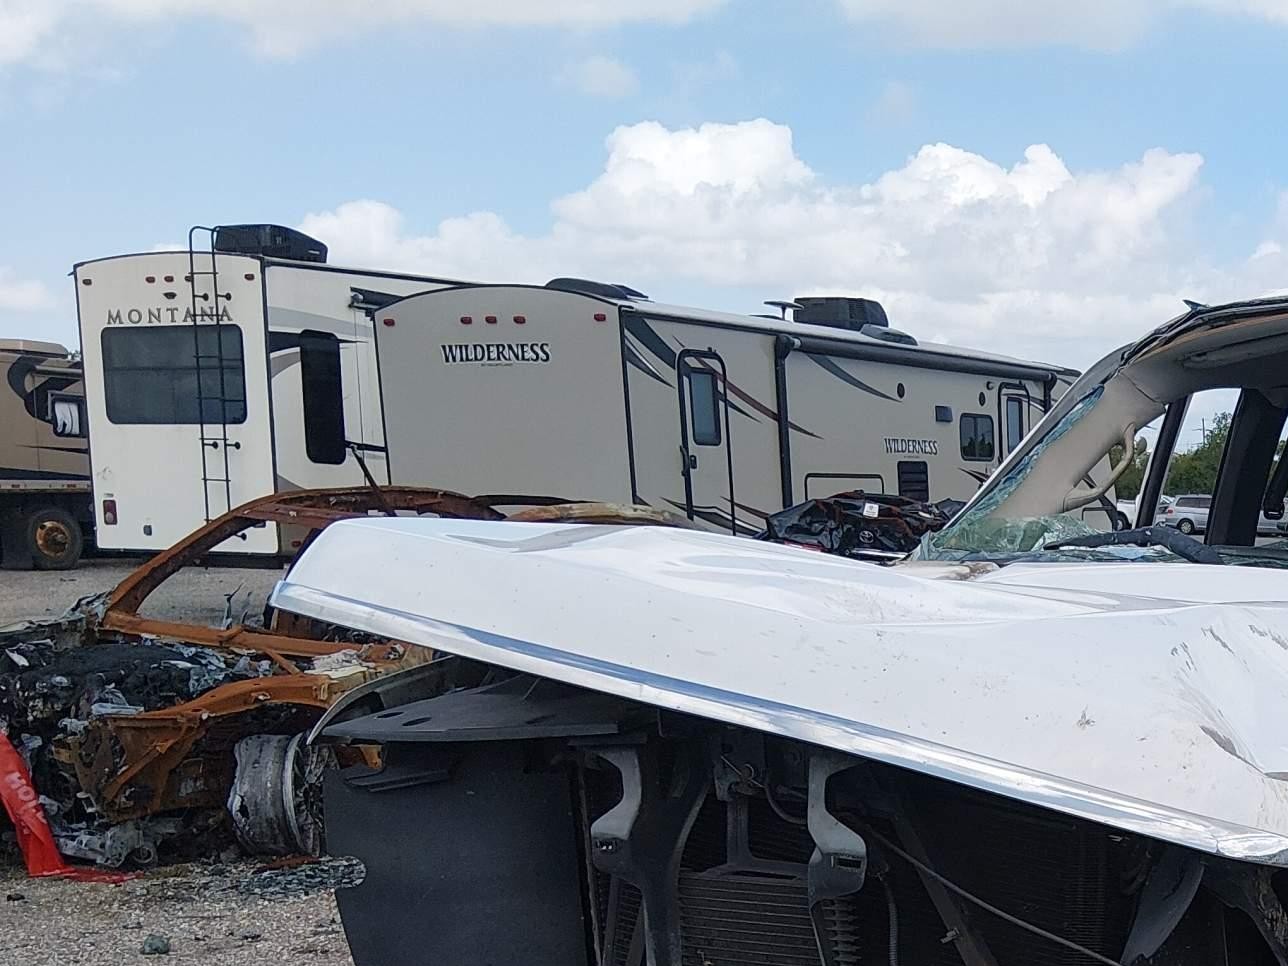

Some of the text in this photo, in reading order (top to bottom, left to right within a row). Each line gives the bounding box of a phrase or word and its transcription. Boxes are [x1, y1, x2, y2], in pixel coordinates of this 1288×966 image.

[106, 304, 233, 325] MONTANA
[440, 342, 550, 363] WILDERNESS
[883, 437, 938, 456] WILDERNESS
